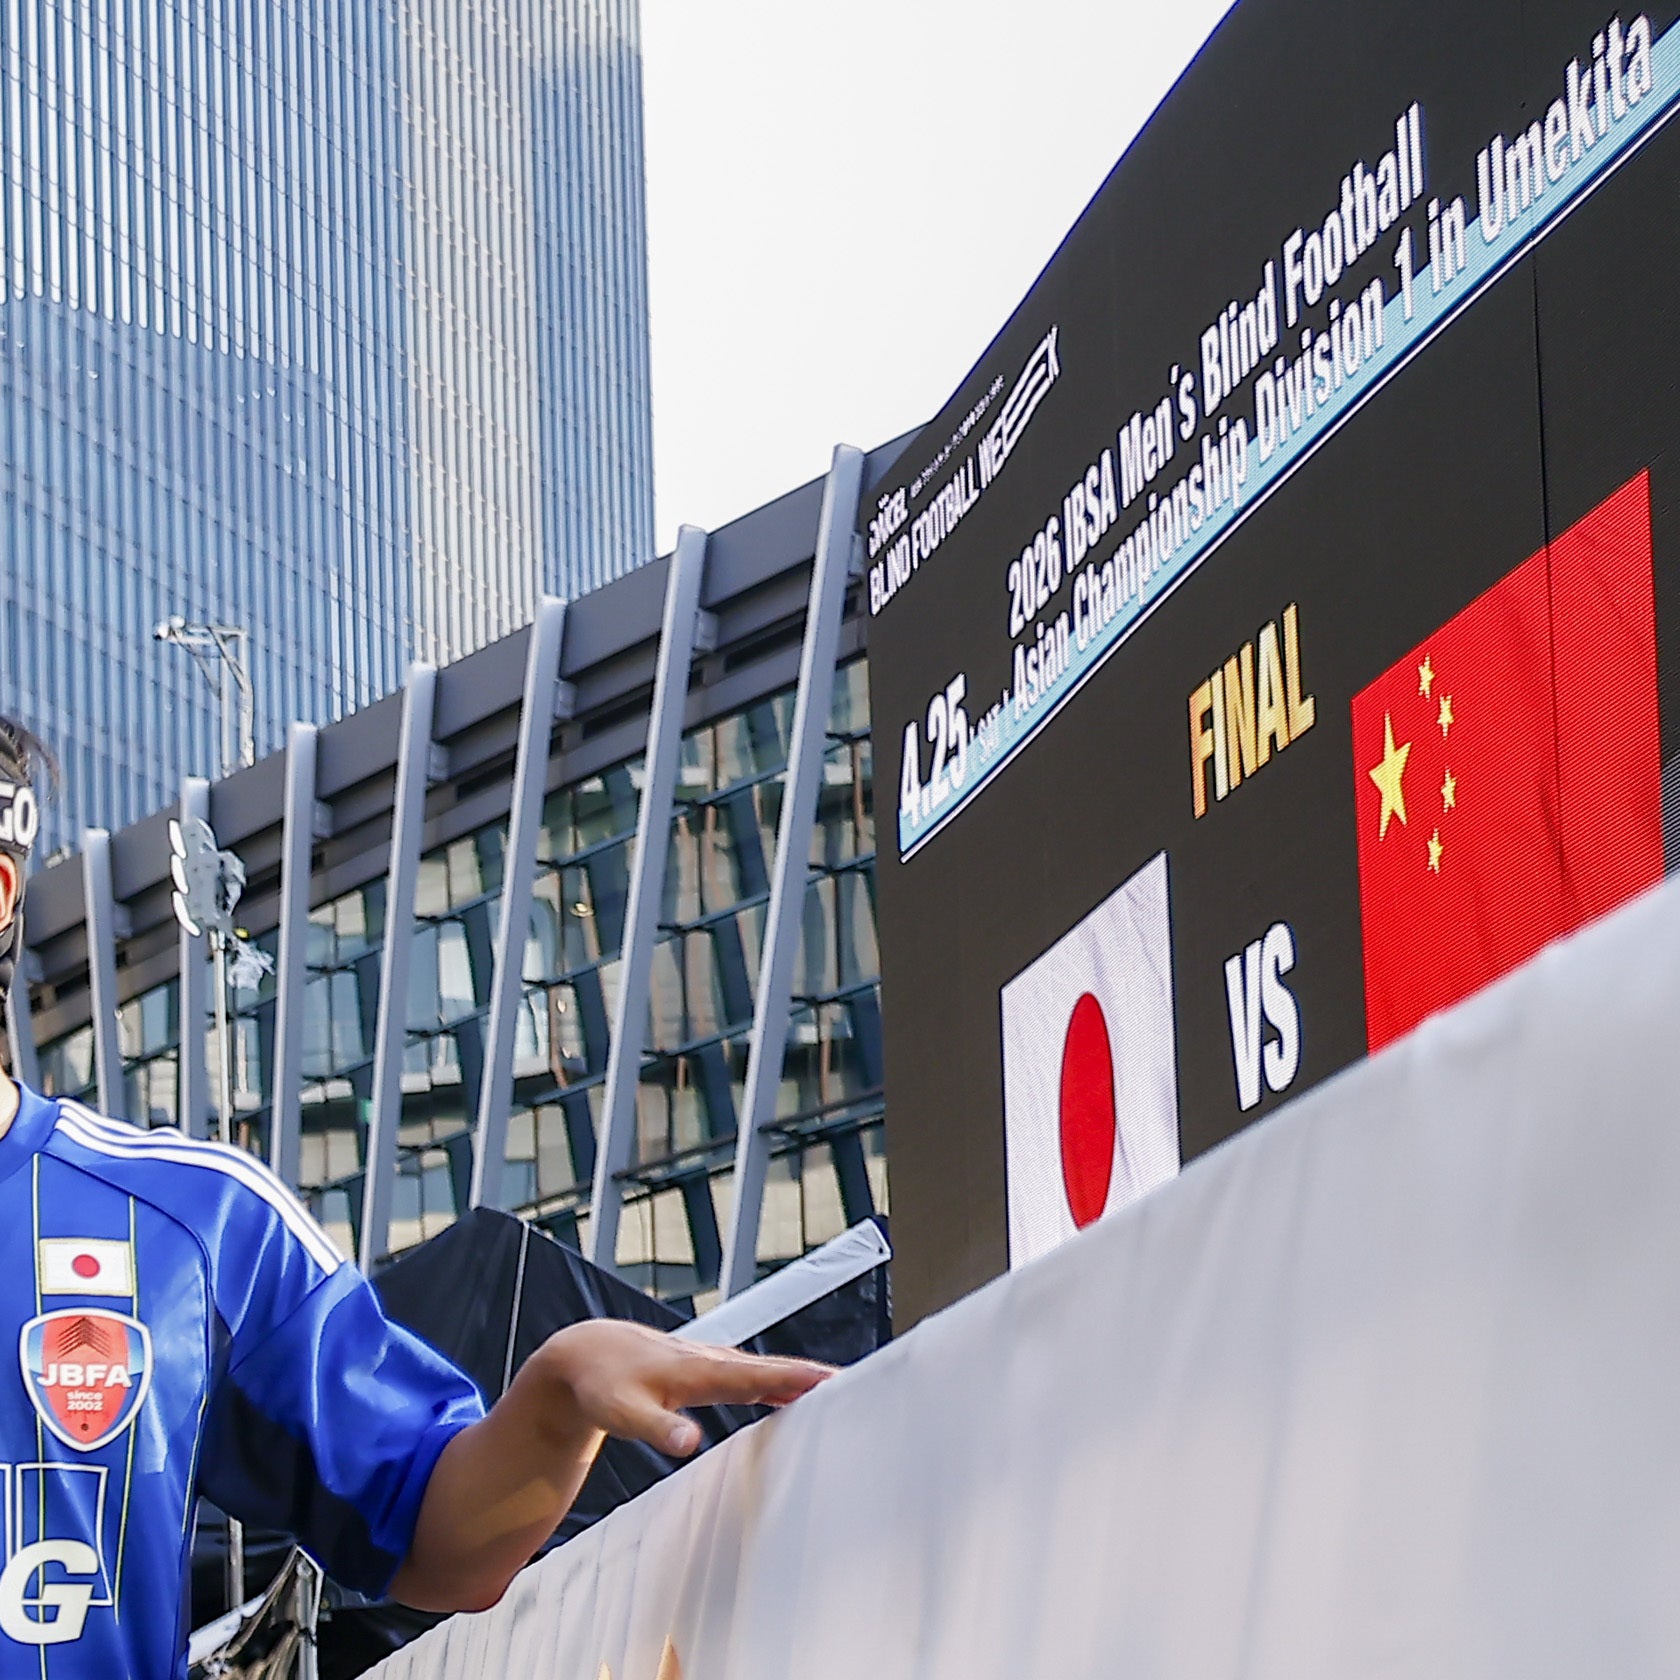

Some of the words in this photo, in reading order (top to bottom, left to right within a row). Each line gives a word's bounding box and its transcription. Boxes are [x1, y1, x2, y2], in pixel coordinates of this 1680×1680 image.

[1008, 515, 1062, 638] 2026
[1064, 449, 1117, 573] IBSA
[1119, 364, 1196, 508] Men's
[1201, 259, 1279, 417] Blind
[1283, 101, 1424, 328] Football
[1013, 610, 1070, 722] Asian
[1073, 417, 1248, 652] Championship
[1255, 278, 1384, 465] Division
[1394, 226, 1414, 322] 1
[1428, 195, 1466, 295] in
[1476, 12, 1653, 243] Umekita
[869, 533, 911, 617] BLIND
[911, 456, 980, 571] FOOTBALL
[1189, 602, 1316, 819] FINAL
[1224, 921, 1303, 1112] VS
[36, 1363, 132, 1388] JBFA
[66, 1390, 103, 1400] since
[66, 1401, 103, 1411] 2002
